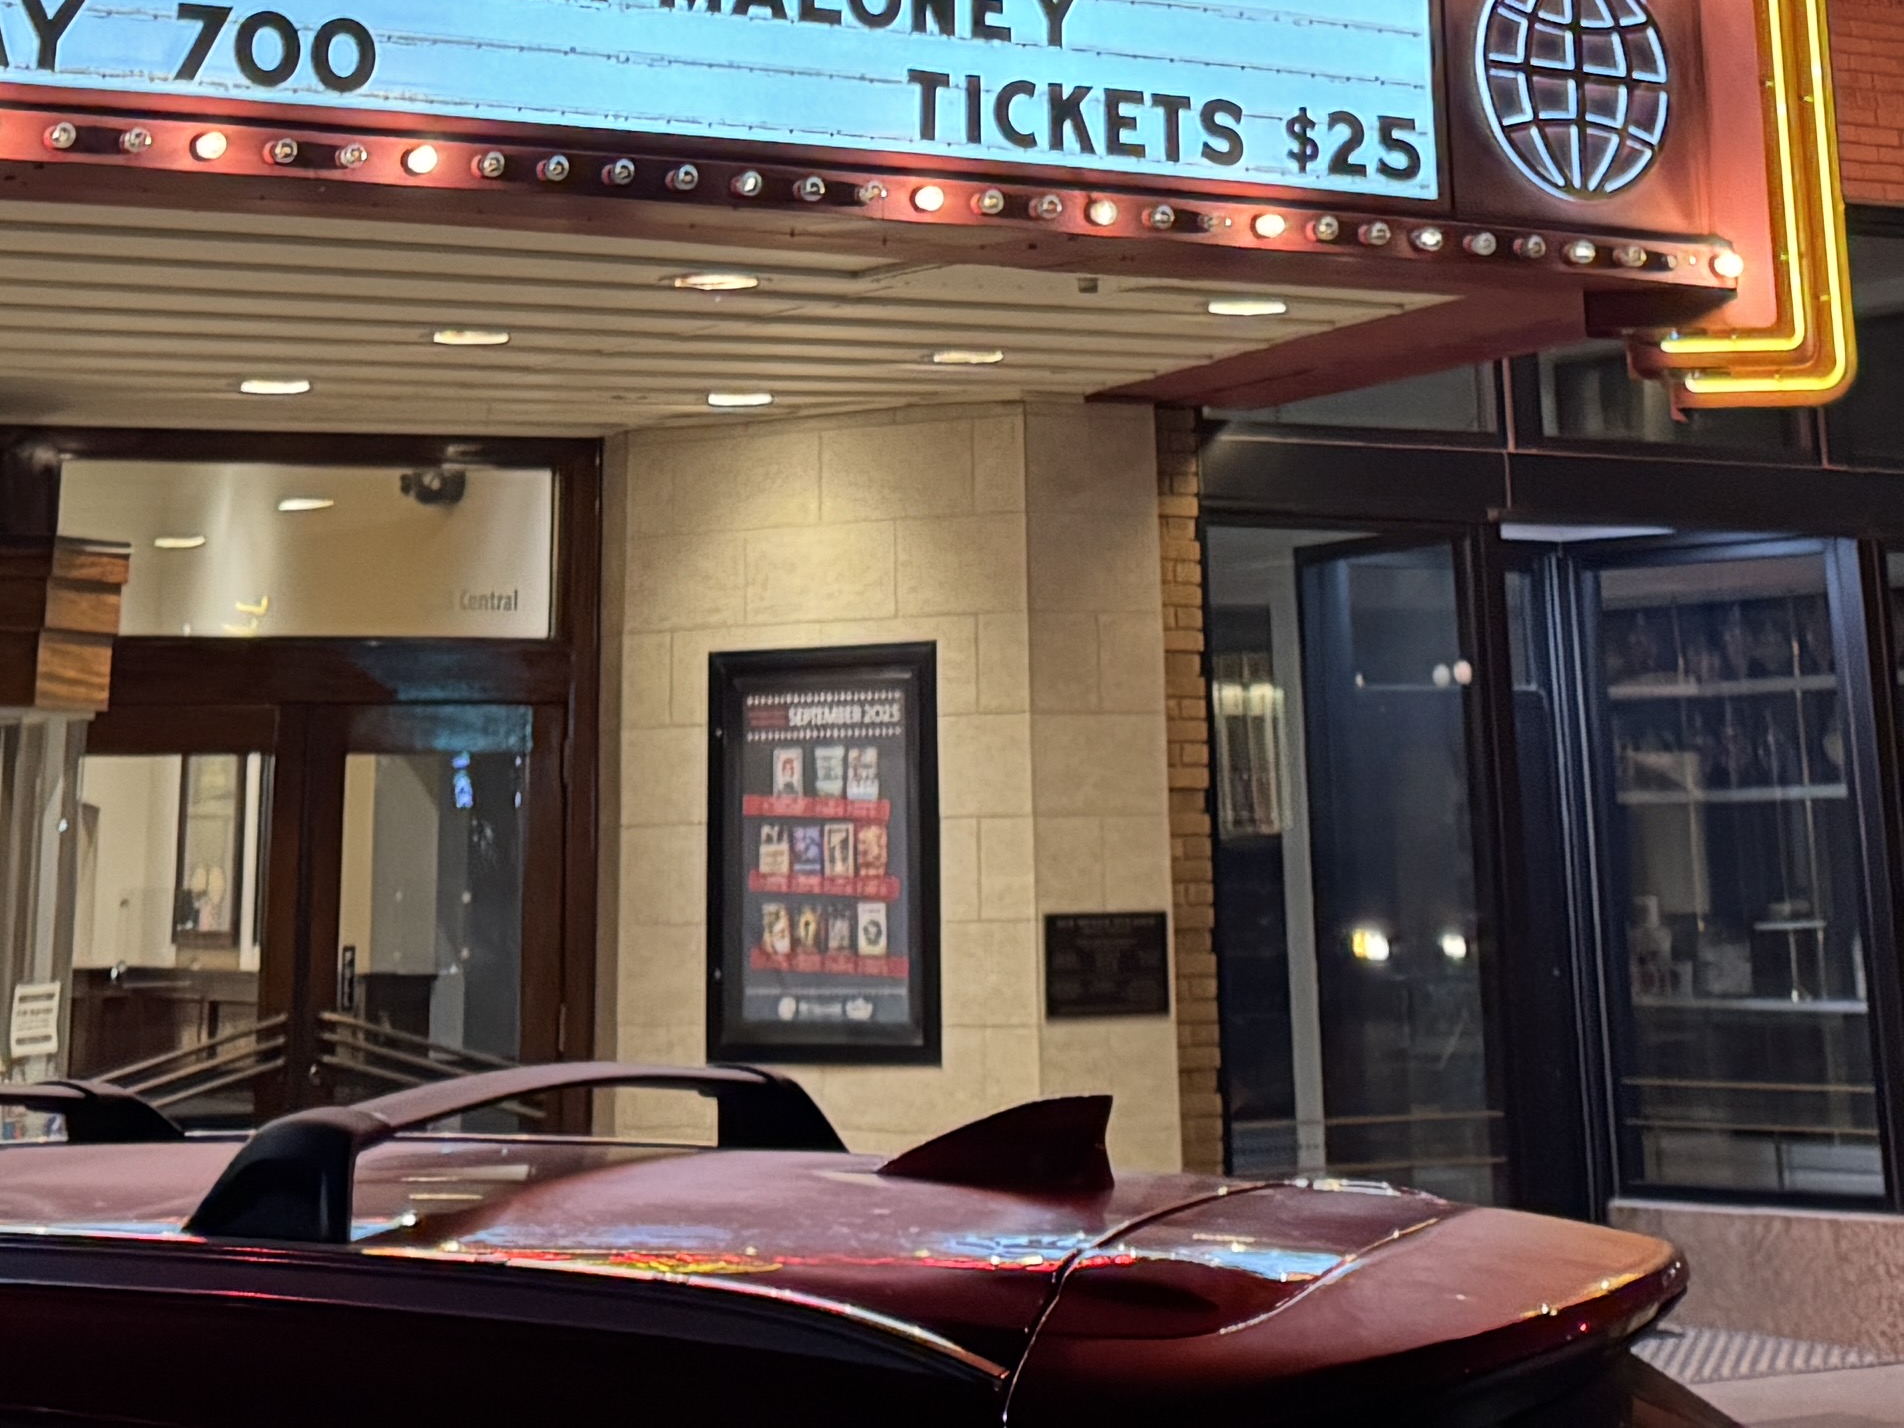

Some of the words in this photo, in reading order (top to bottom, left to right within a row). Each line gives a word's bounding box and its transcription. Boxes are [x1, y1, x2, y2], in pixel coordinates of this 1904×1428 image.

[172, 2, 377, 94] 700
[906, 67, 1246, 167] TICKETS
[1284, 106, 1422, 182] $25
